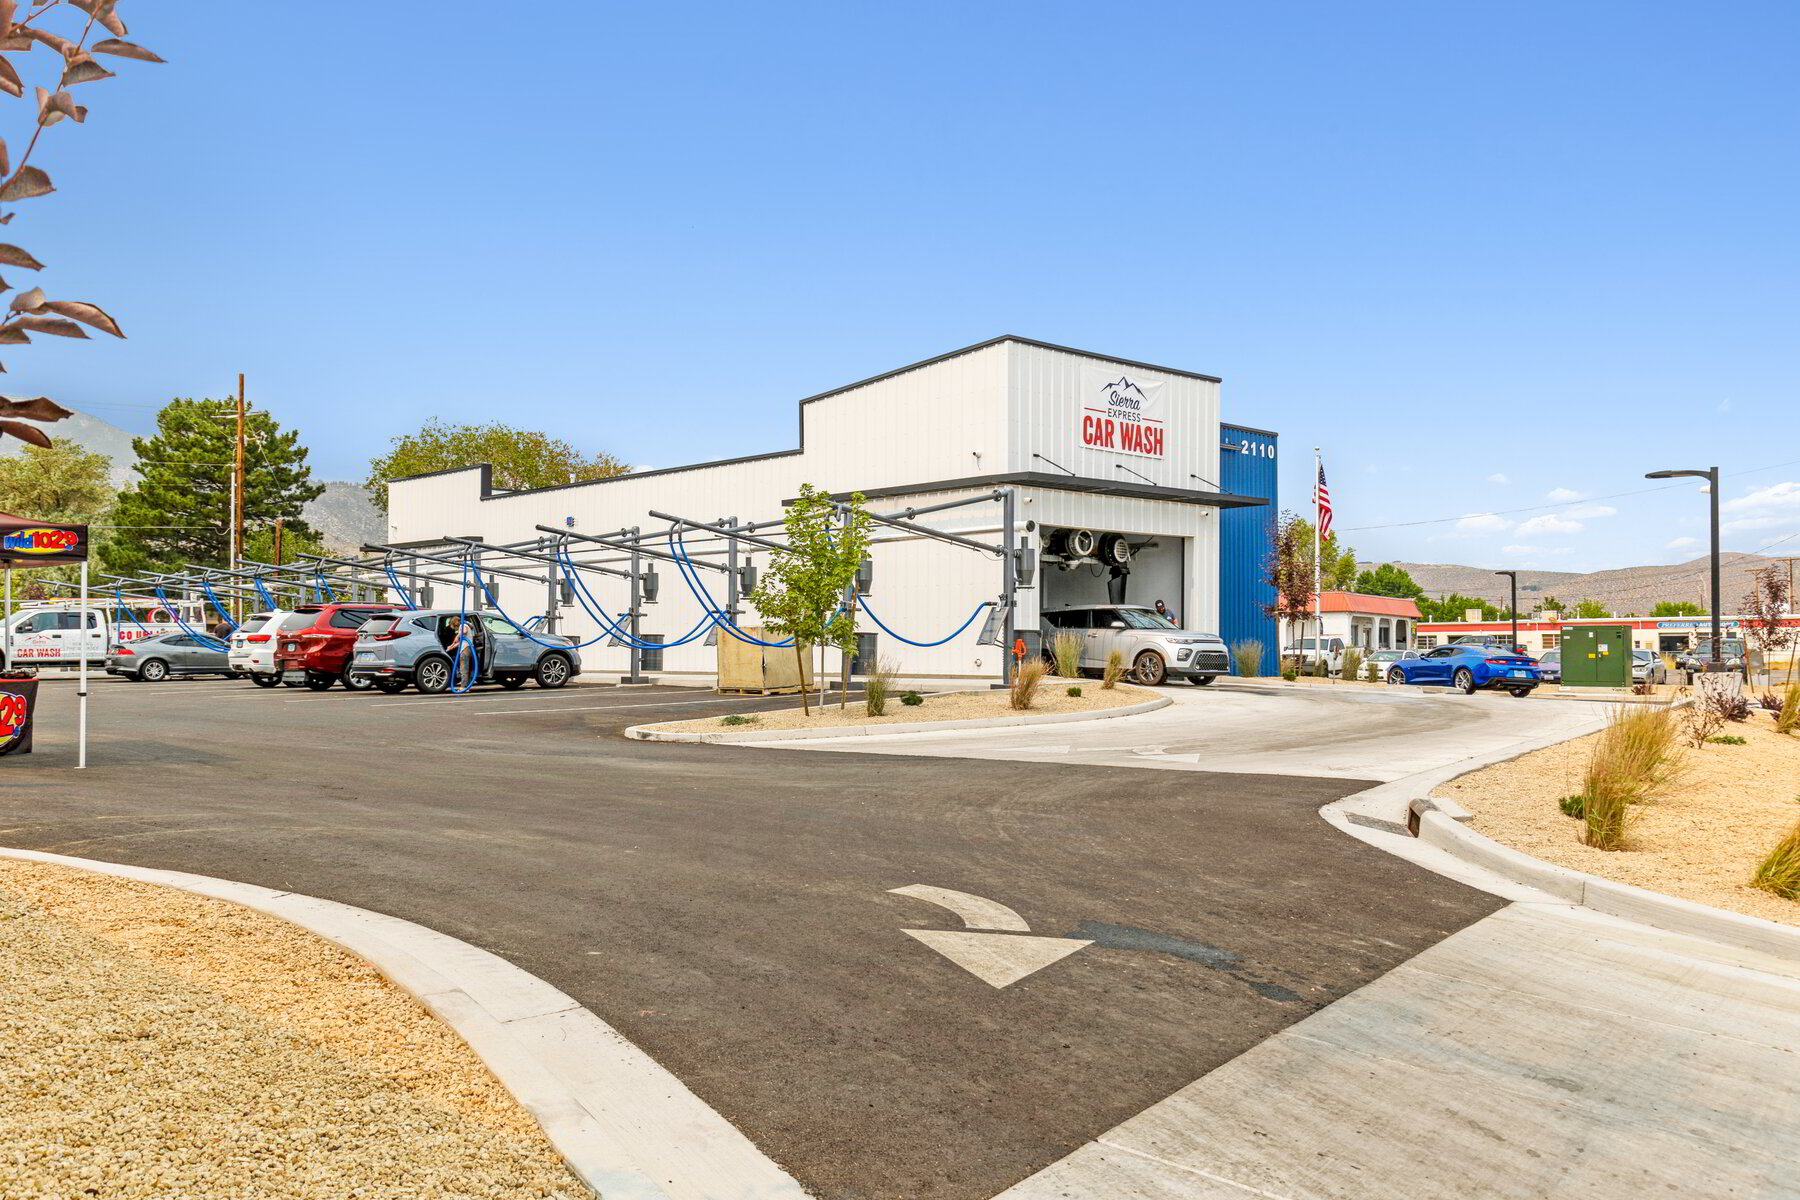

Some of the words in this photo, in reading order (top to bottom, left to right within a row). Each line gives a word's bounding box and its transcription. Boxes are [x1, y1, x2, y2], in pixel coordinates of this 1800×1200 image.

[1108, 390, 1141, 411] Sierra
[1107, 408, 1141, 422] EXPRESS
[1083, 415, 1115, 448] CAR
[1120, 421, 1163, 456] WASH
[1241, 440, 1275, 459] 2110
[17, 648, 34, 658] CAR
[37, 648, 61, 658] WASH
